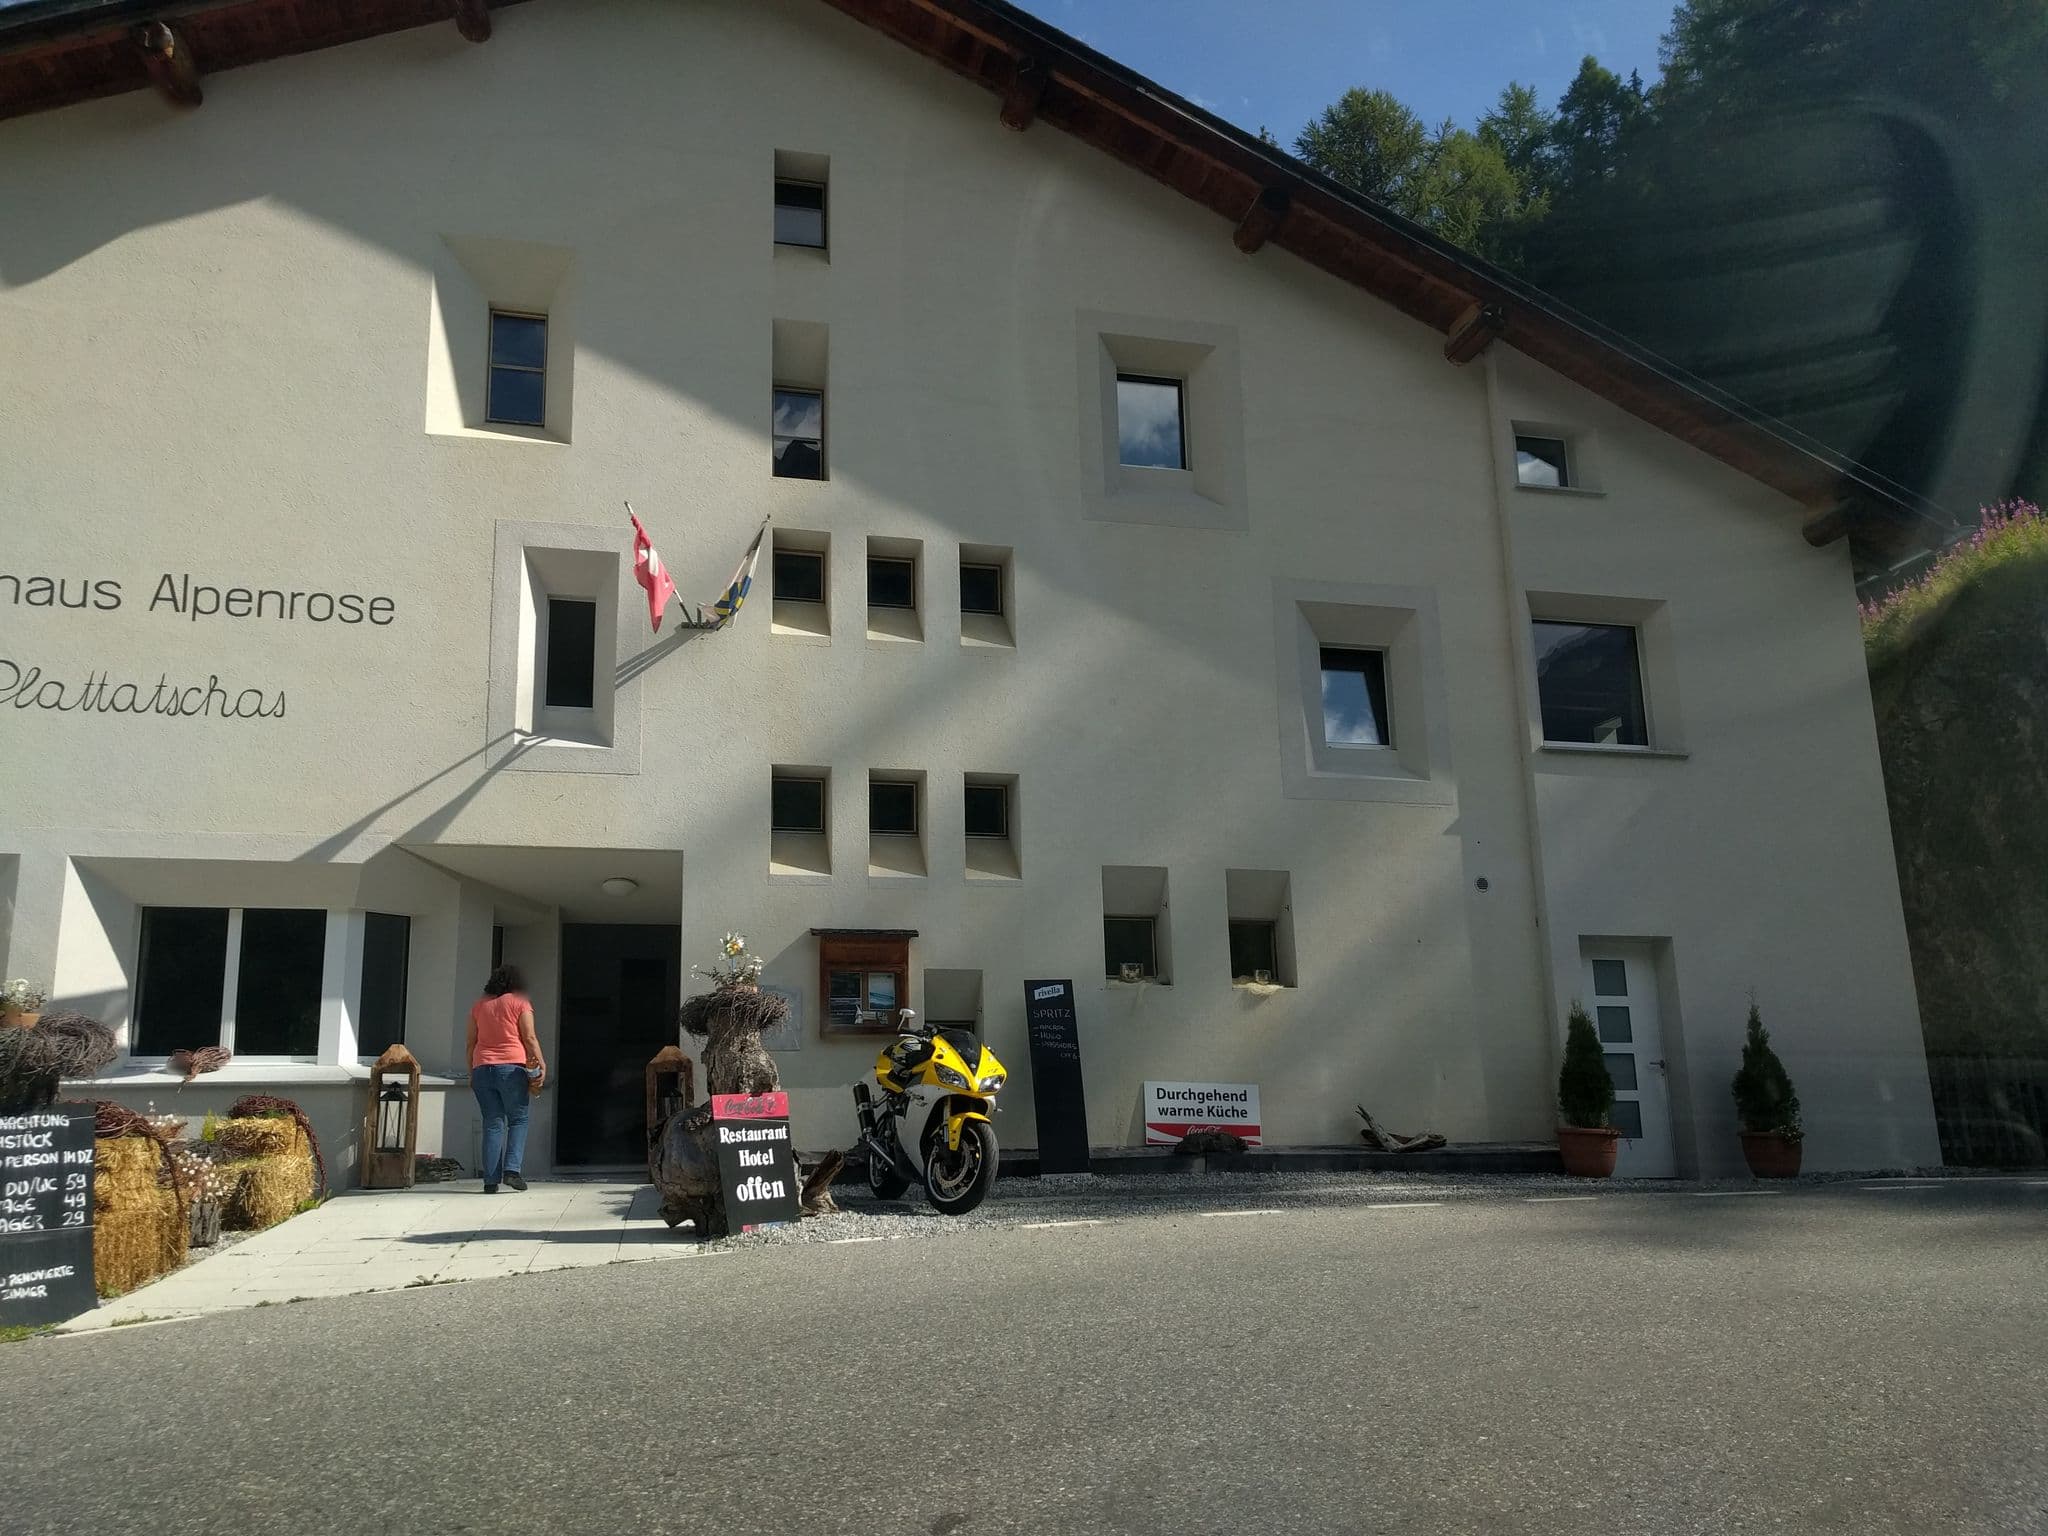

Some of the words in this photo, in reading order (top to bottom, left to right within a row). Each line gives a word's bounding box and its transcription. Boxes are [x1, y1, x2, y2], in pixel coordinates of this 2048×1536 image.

[149, 573, 395, 625] Alpenrose
[1032, 1008, 1072, 1019] SPRITZ
[1156, 1087, 1248, 1104] Durchgehend
[1158, 1106, 1204, 1118] warme
[1207, 1105, 1248, 1119] Küche
[719, 1125, 788, 1144] Restaurant
[5, 1151, 59, 1168] PERSON
[77, 1149, 94, 1164] DZ
[738, 1148, 775, 1167] Hotel
[5, 1176, 58, 1197] DU/WC
[65, 1173, 87, 1190] 59
[736, 1176, 786, 1202] offen
[64, 1192, 86, 1208] 49
[62, 1210, 85, 1226] 29
[1, 1284, 48, 1300] ZIMMER
